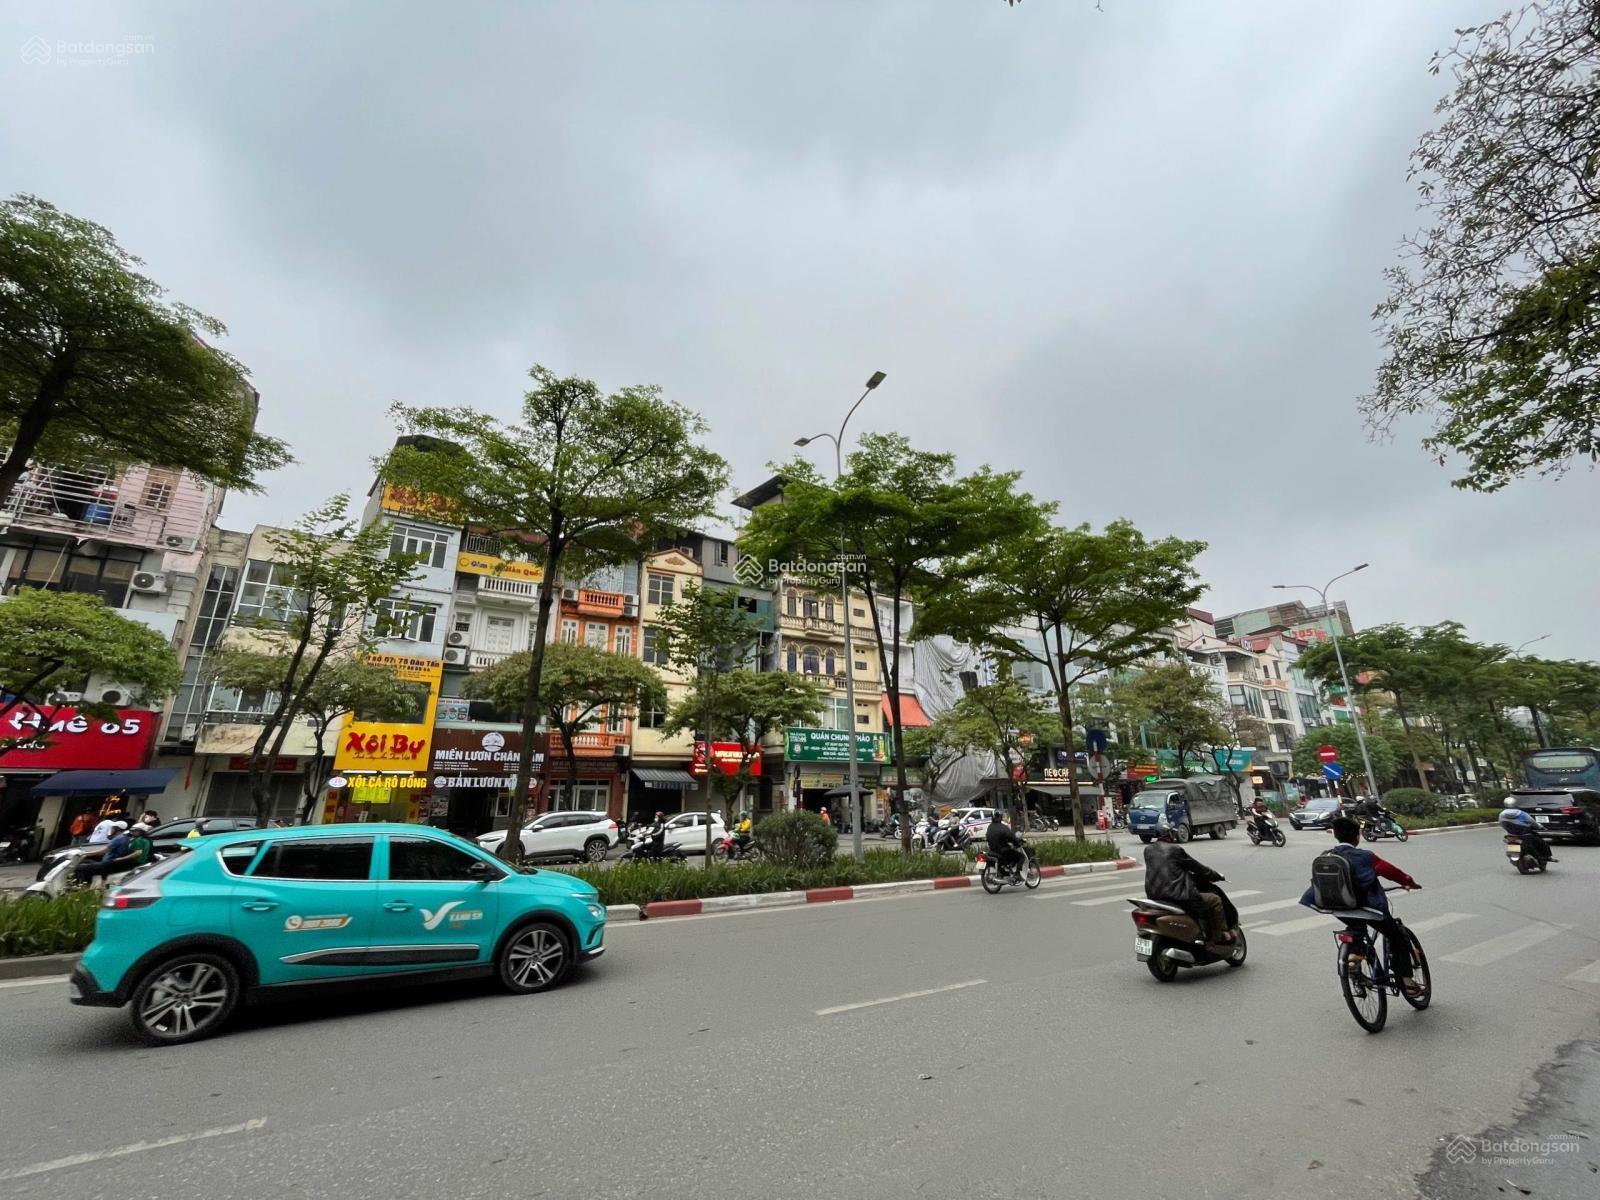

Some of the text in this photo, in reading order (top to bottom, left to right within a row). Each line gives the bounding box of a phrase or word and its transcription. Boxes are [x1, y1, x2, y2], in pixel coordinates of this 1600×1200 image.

[346, 732, 388, 753] Xôi
[811, 731, 830, 741] QUÁN
[830, 733, 850, 742] CHUN
[435, 747, 464, 760] MIẾN
[464, 750, 492, 761] LƯƠN
[493, 750, 521, 762] CHÂN
[347, 774, 368, 788] XÔI
[384, 775, 399, 789] RÔ
